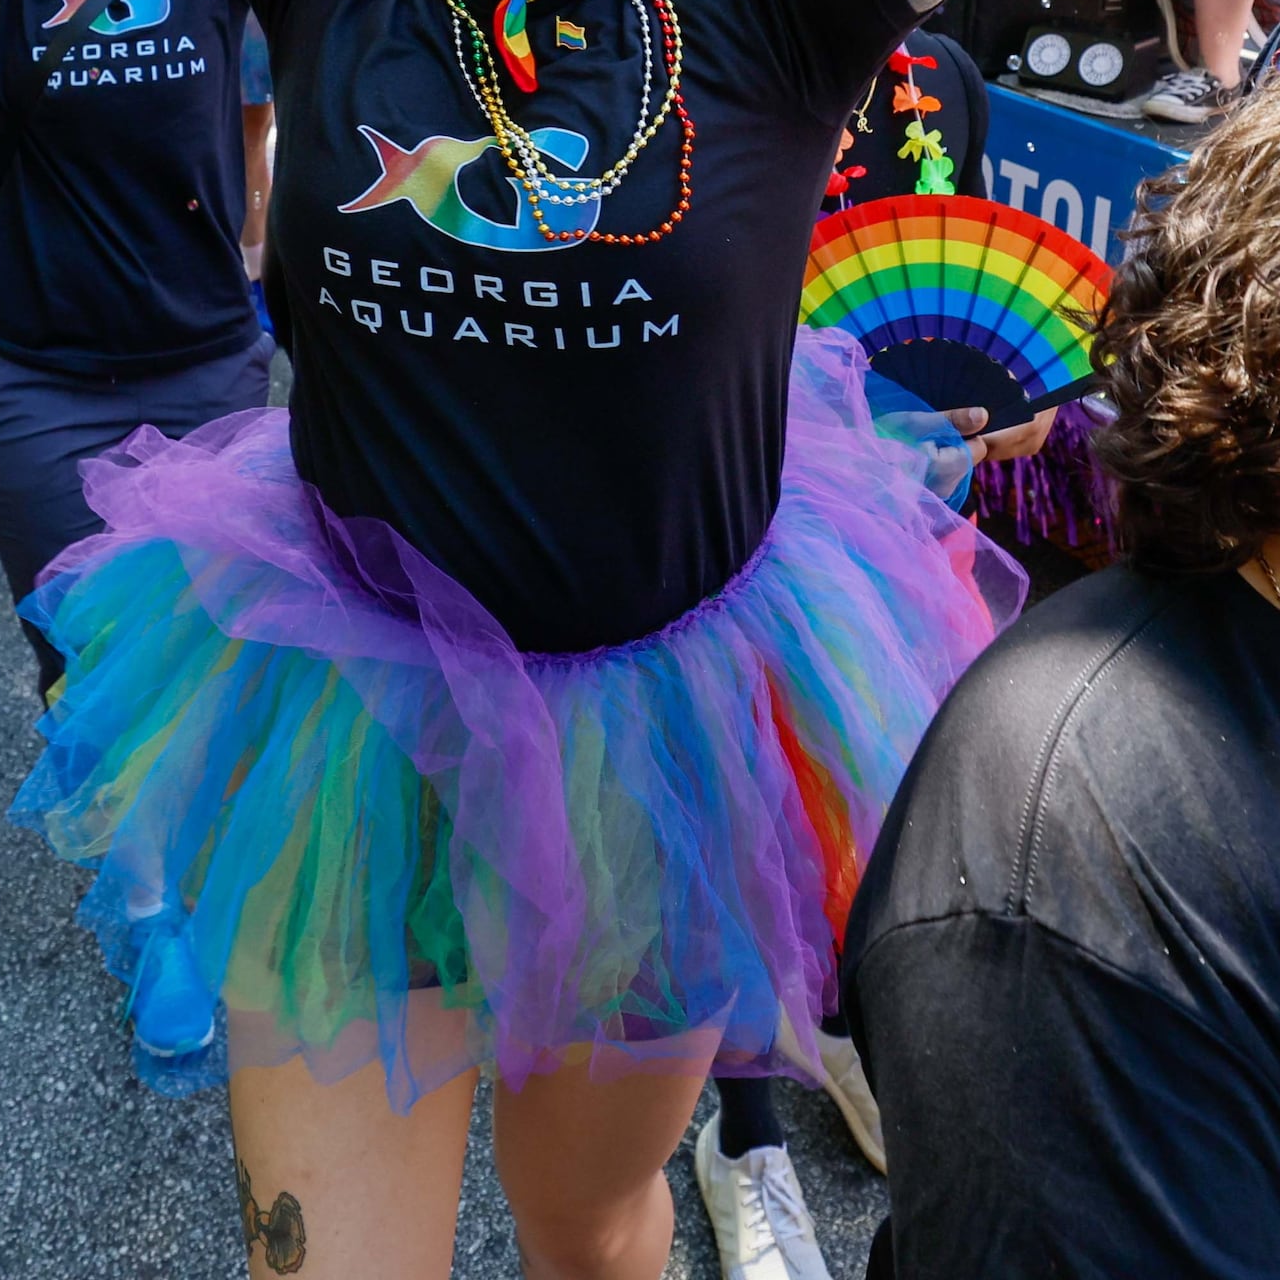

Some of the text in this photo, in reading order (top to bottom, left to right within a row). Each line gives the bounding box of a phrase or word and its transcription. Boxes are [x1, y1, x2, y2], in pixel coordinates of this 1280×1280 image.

[46, 58, 206, 90] QUARIUM
[323, 246, 653, 308] GEORGIA
[318, 286, 680, 350] AQUARIUM
